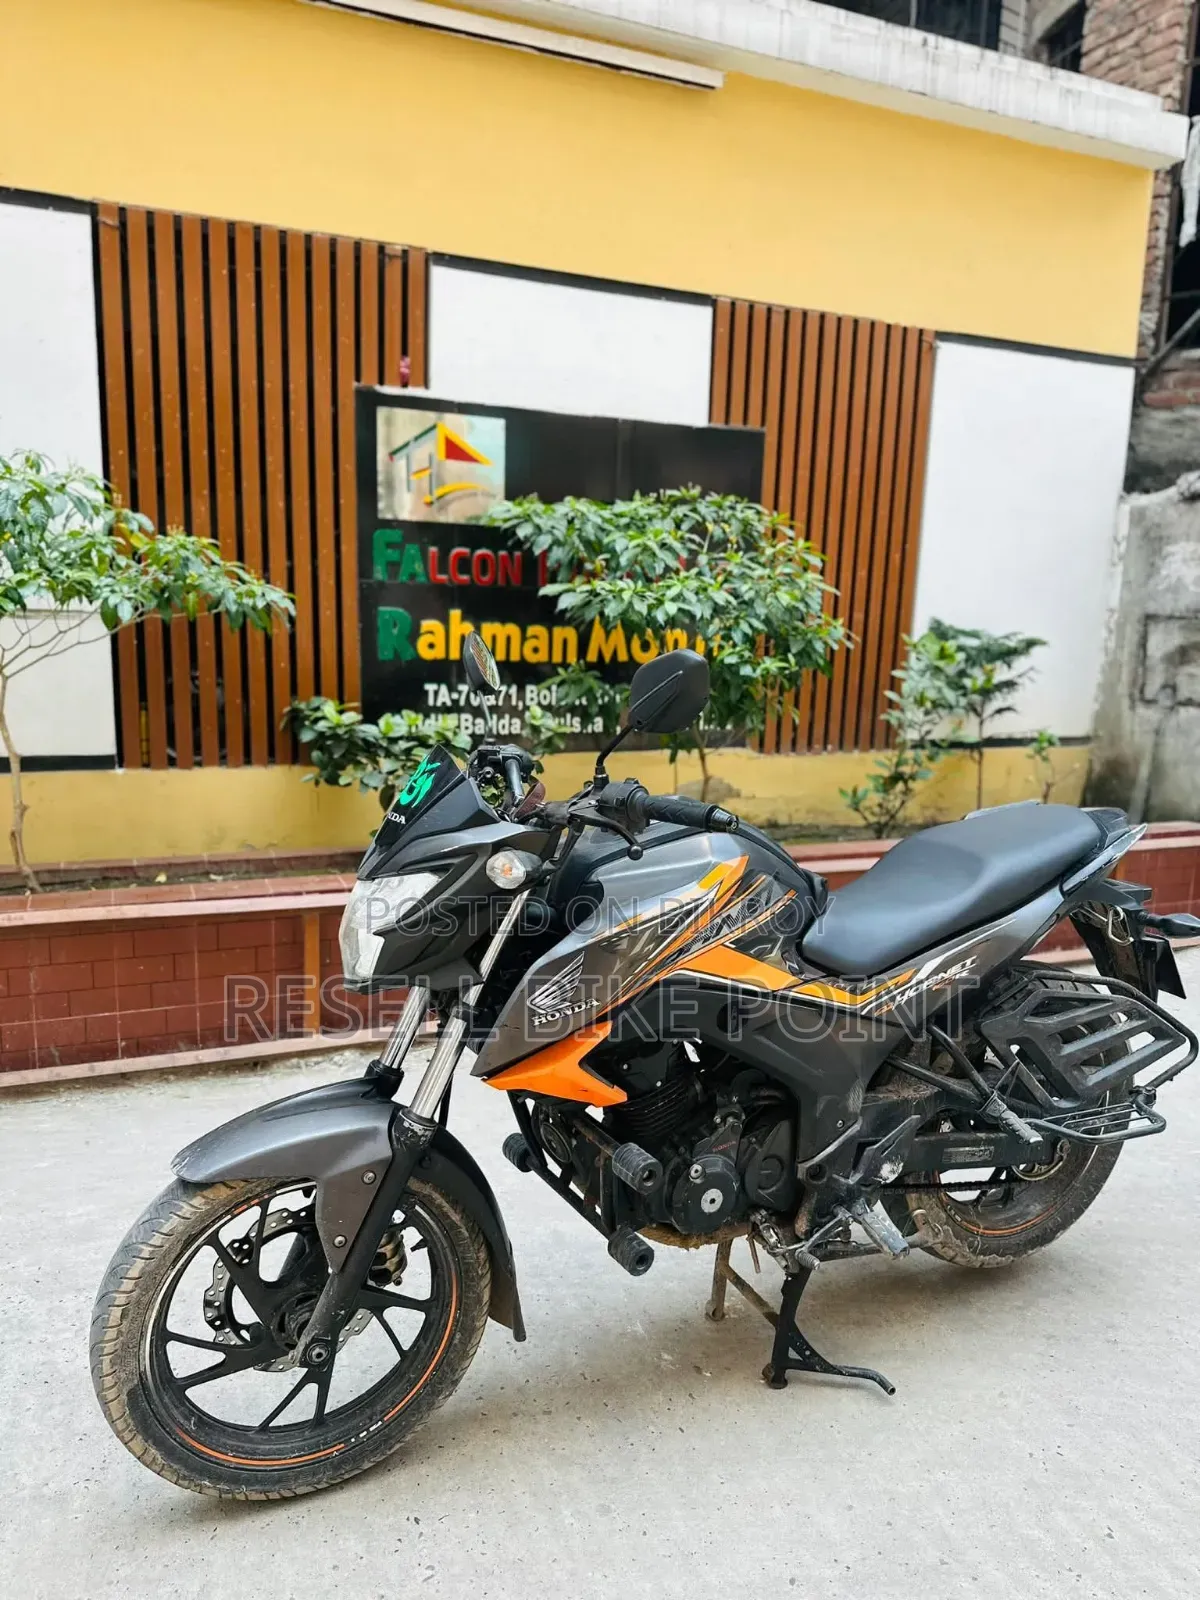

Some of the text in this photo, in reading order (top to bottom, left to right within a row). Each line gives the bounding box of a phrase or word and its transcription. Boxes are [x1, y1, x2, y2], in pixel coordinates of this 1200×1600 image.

[373, 528, 523, 586] FALCON
[377, 606, 578, 664] Rahman
[531, 998, 601, 1026] HONDA
